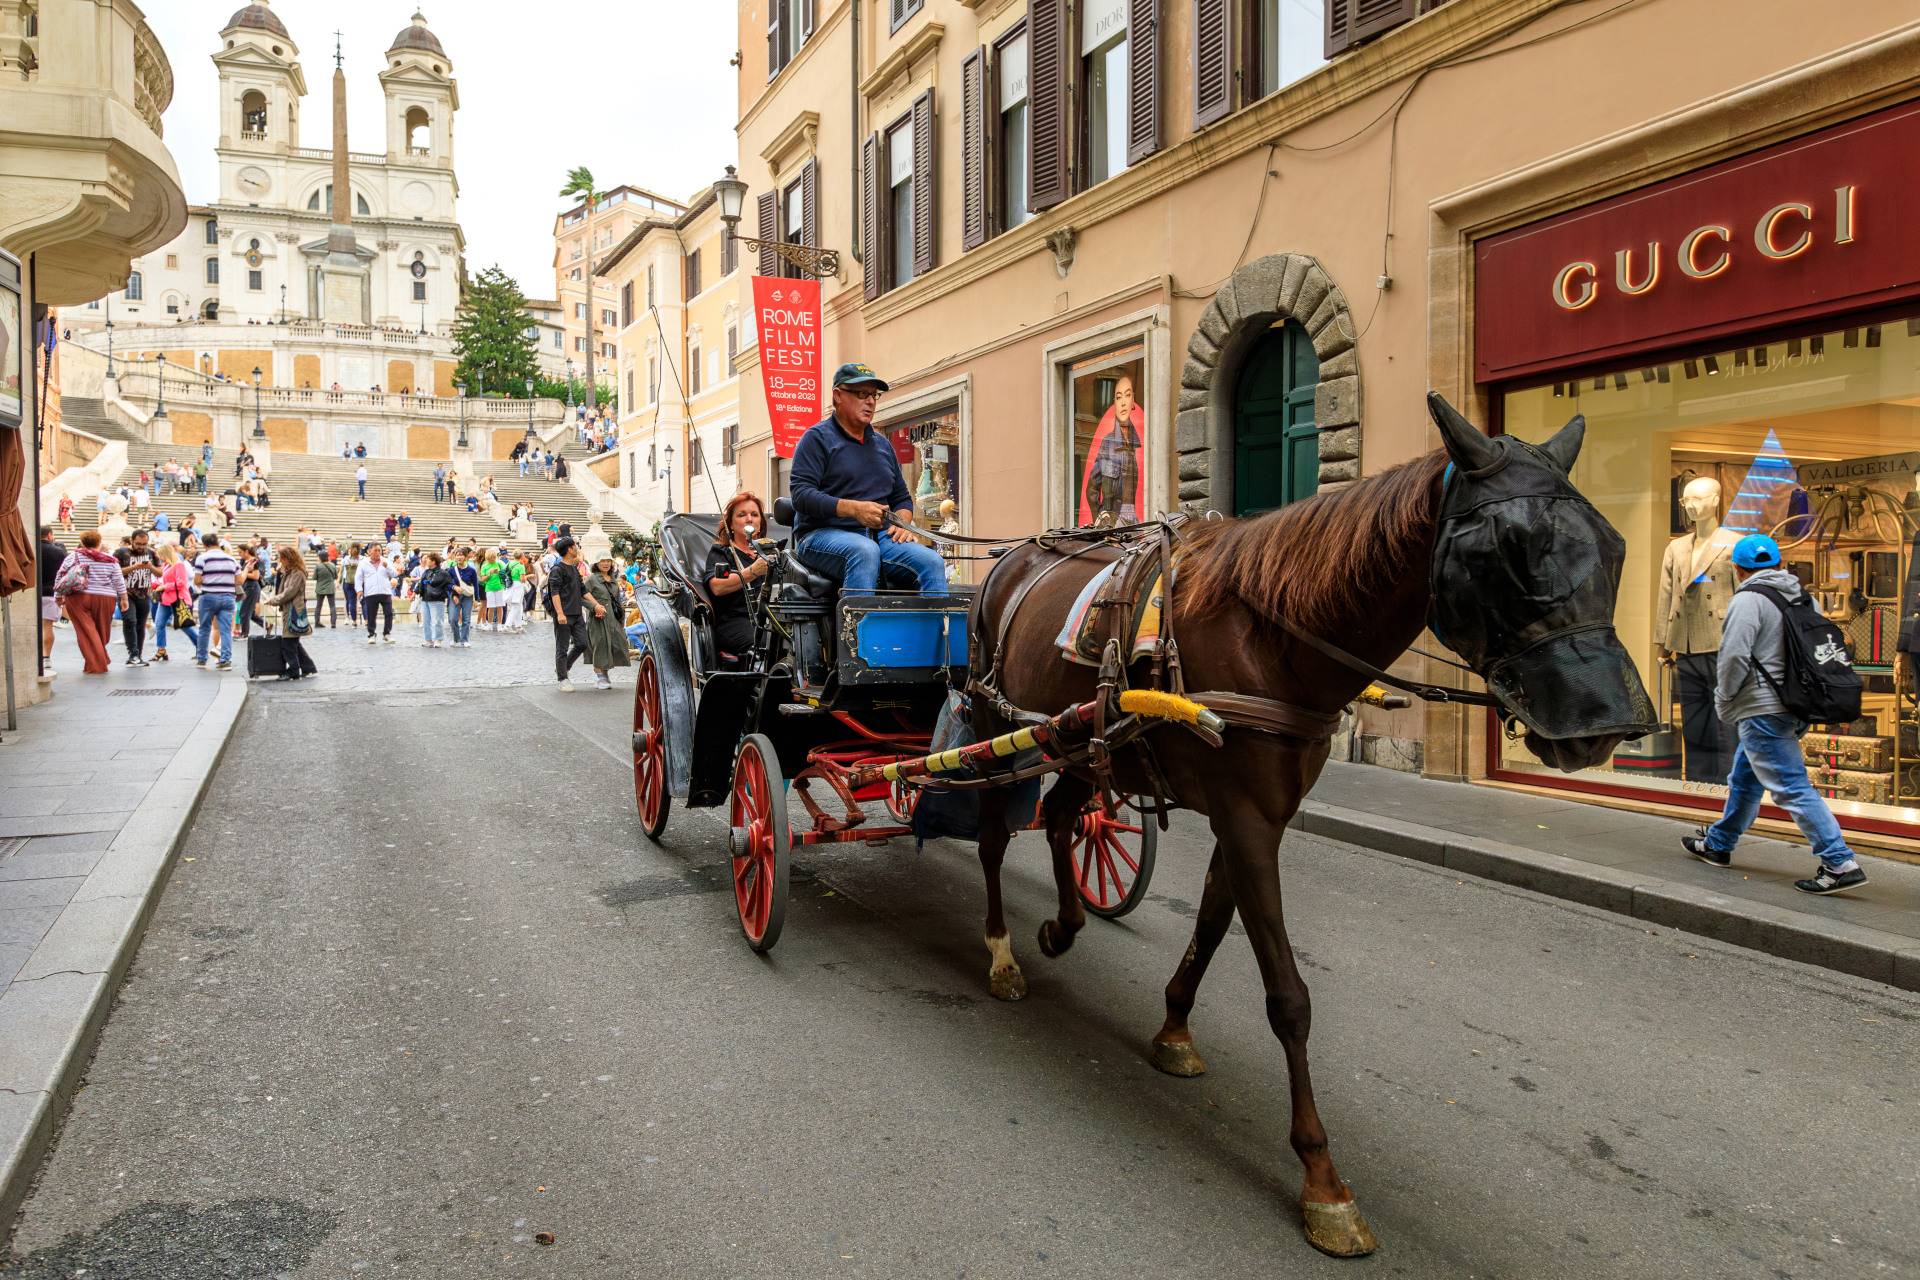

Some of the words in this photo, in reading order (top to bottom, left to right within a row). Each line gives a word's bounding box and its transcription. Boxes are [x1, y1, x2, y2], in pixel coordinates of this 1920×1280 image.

[1096, 6, 1124, 36] DIOR
[1011, 74, 1027, 96] DIO
[1552, 185, 1856, 310] GUCCI
[763, 308, 814, 327] ROME
[764, 328, 815, 347] FILM
[766, 348, 815, 367] FEST
[770, 391, 797, 400] ottobre
[797, 392, 816, 401] 2023
[787, 405, 813, 413] Edizione
[1808, 459, 1910, 480] VALIGERIA
